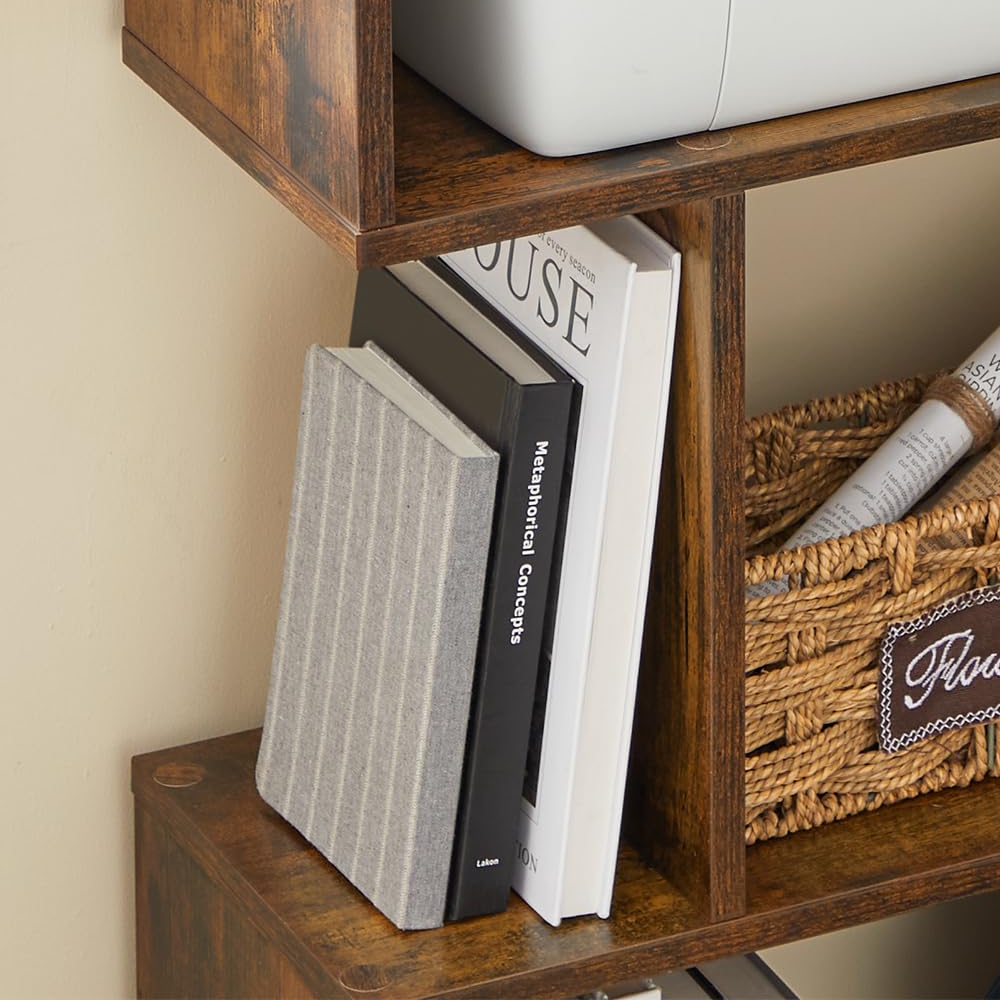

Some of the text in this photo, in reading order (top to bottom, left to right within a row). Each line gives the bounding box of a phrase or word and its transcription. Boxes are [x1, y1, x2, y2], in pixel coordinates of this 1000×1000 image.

[546, 236, 568, 262] every
[509, 440, 550, 646] Metaphorical Concepts
